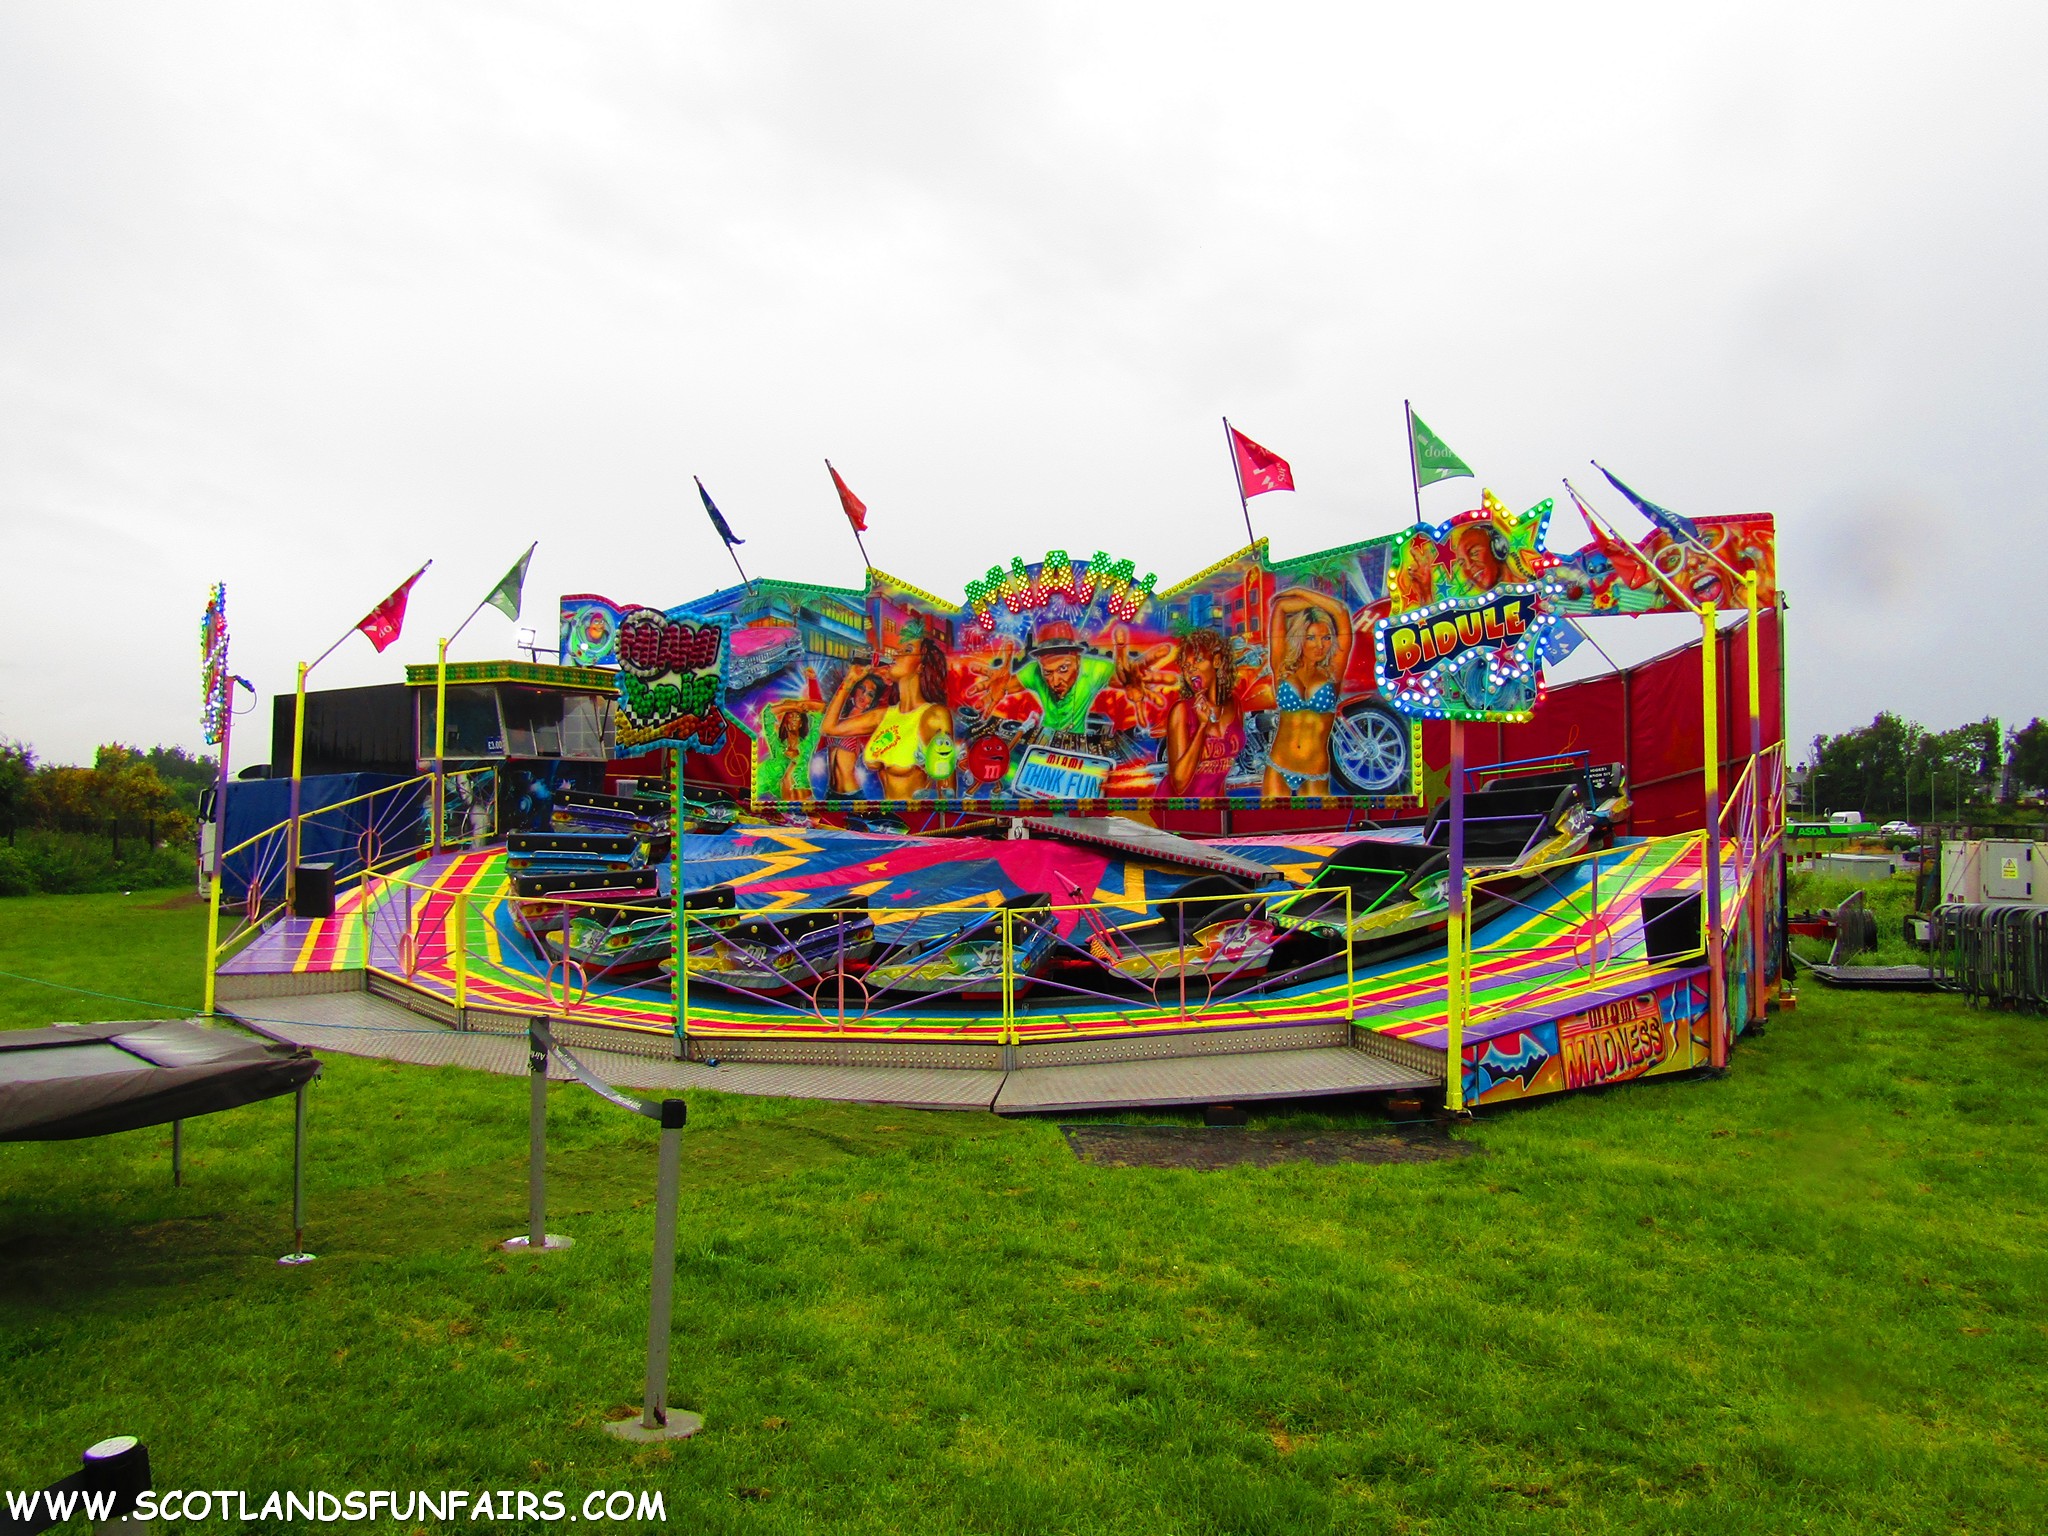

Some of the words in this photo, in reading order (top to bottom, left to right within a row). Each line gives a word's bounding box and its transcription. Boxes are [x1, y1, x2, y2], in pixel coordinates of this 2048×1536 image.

[964, 550, 1158, 630] MIAMI
[1046, 753, 1084, 770] MIAMI
[1022, 763, 1066, 793] THINK
[1065, 772, 1104, 799] FUN
[1797, 827, 1827, 836] ASDA
[1565, 1017, 1663, 1089] MADNESS
